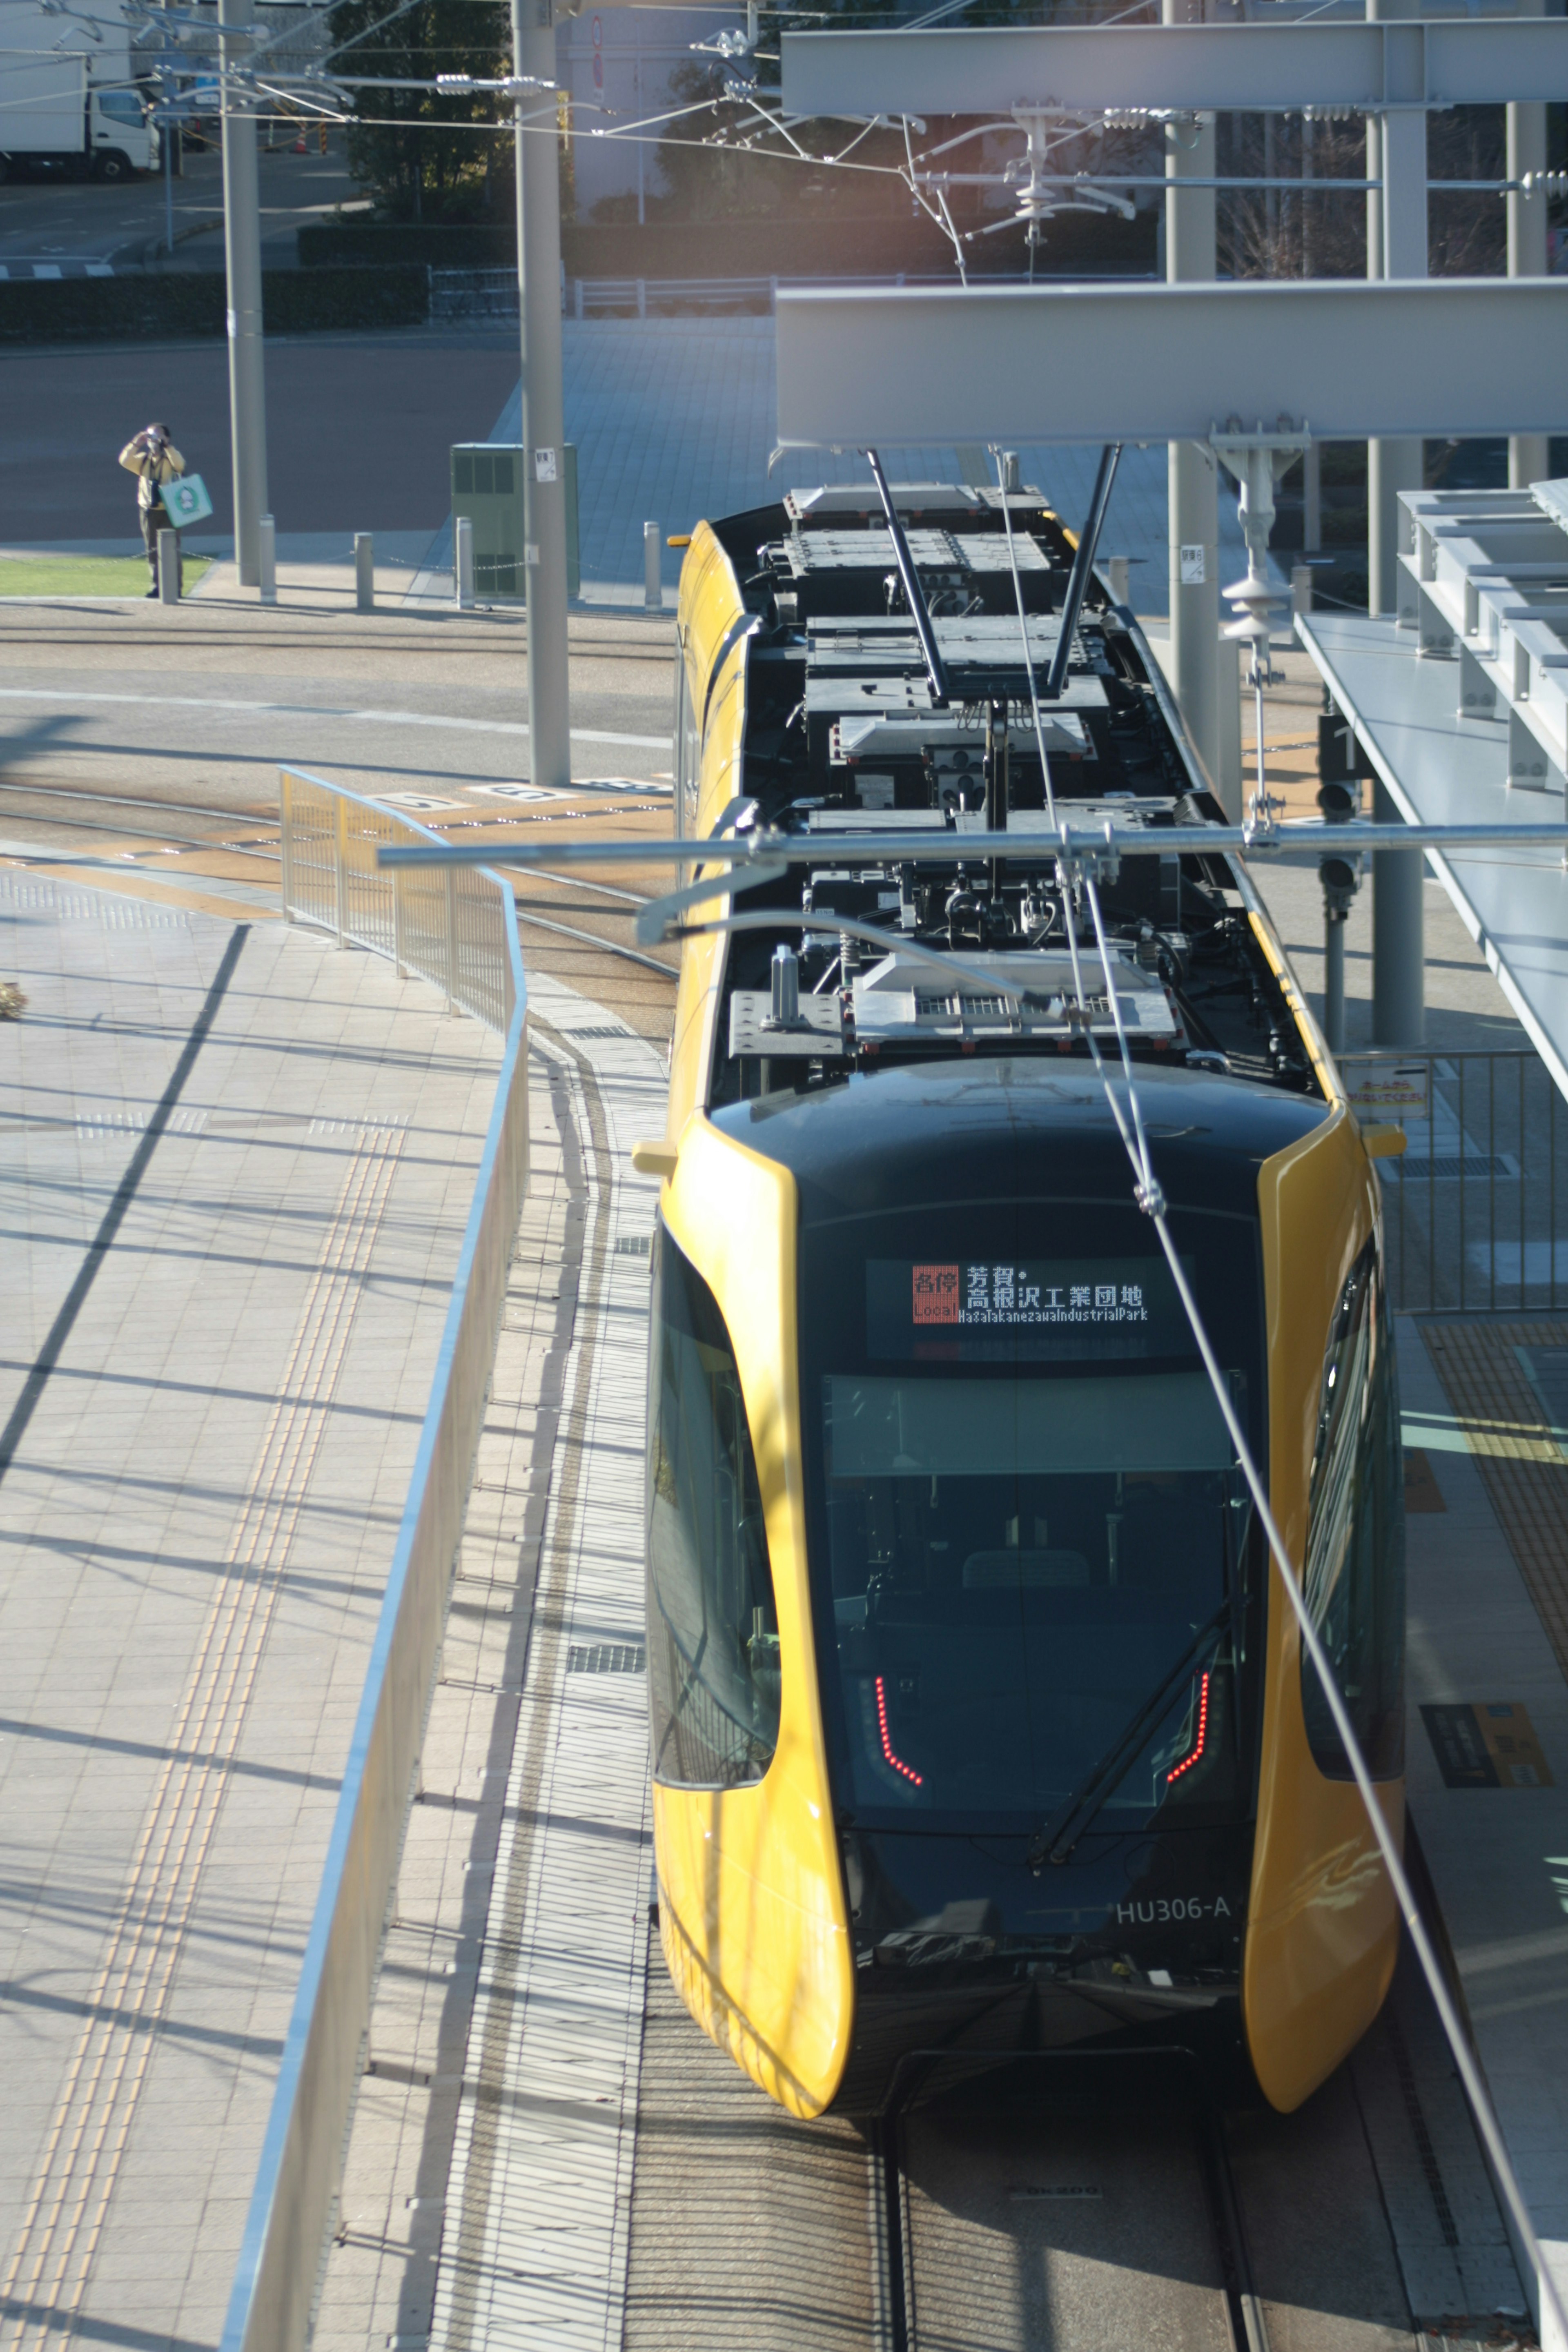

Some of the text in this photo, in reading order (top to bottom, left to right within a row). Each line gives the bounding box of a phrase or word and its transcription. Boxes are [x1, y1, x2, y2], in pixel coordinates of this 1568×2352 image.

[914, 1272, 956, 1293] 各停
[967, 1285, 1143, 1308] 高根沢工業団地
[914, 1302, 956, 1317] Local
[1116, 1896, 1231, 1924] HU306-A
